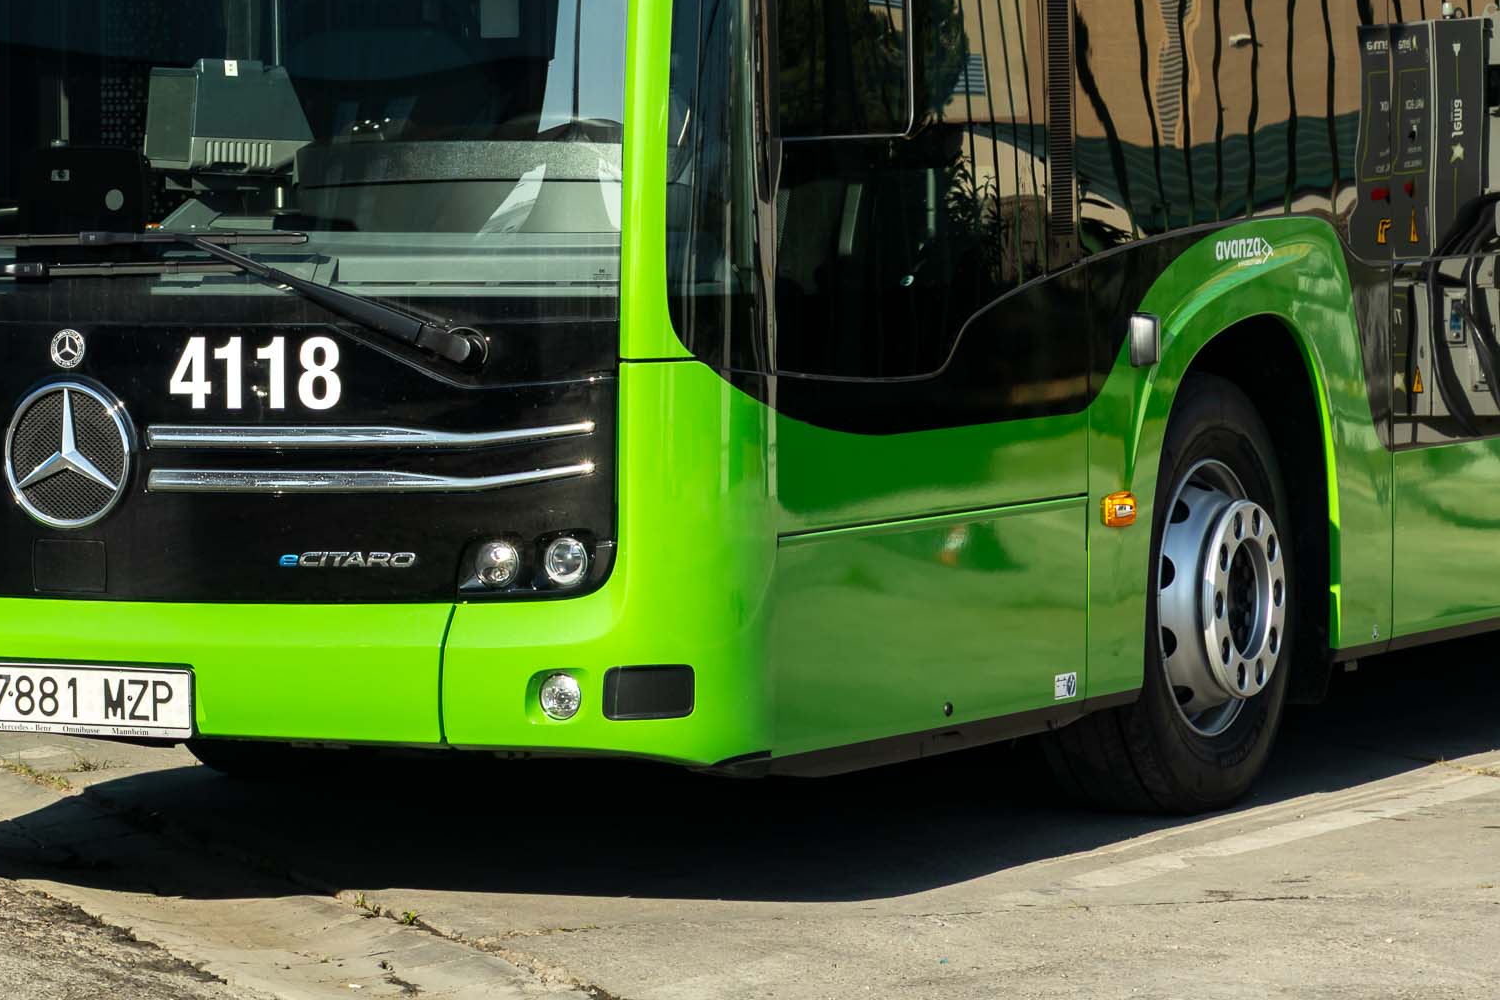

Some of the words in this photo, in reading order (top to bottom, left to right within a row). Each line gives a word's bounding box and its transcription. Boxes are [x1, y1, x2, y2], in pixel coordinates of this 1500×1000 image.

[1215, 236, 1262, 261] avanza
[169, 336, 342, 410] 4118
[279, 551, 417, 568] eCITARO
[103, 677, 174, 722] MZP
